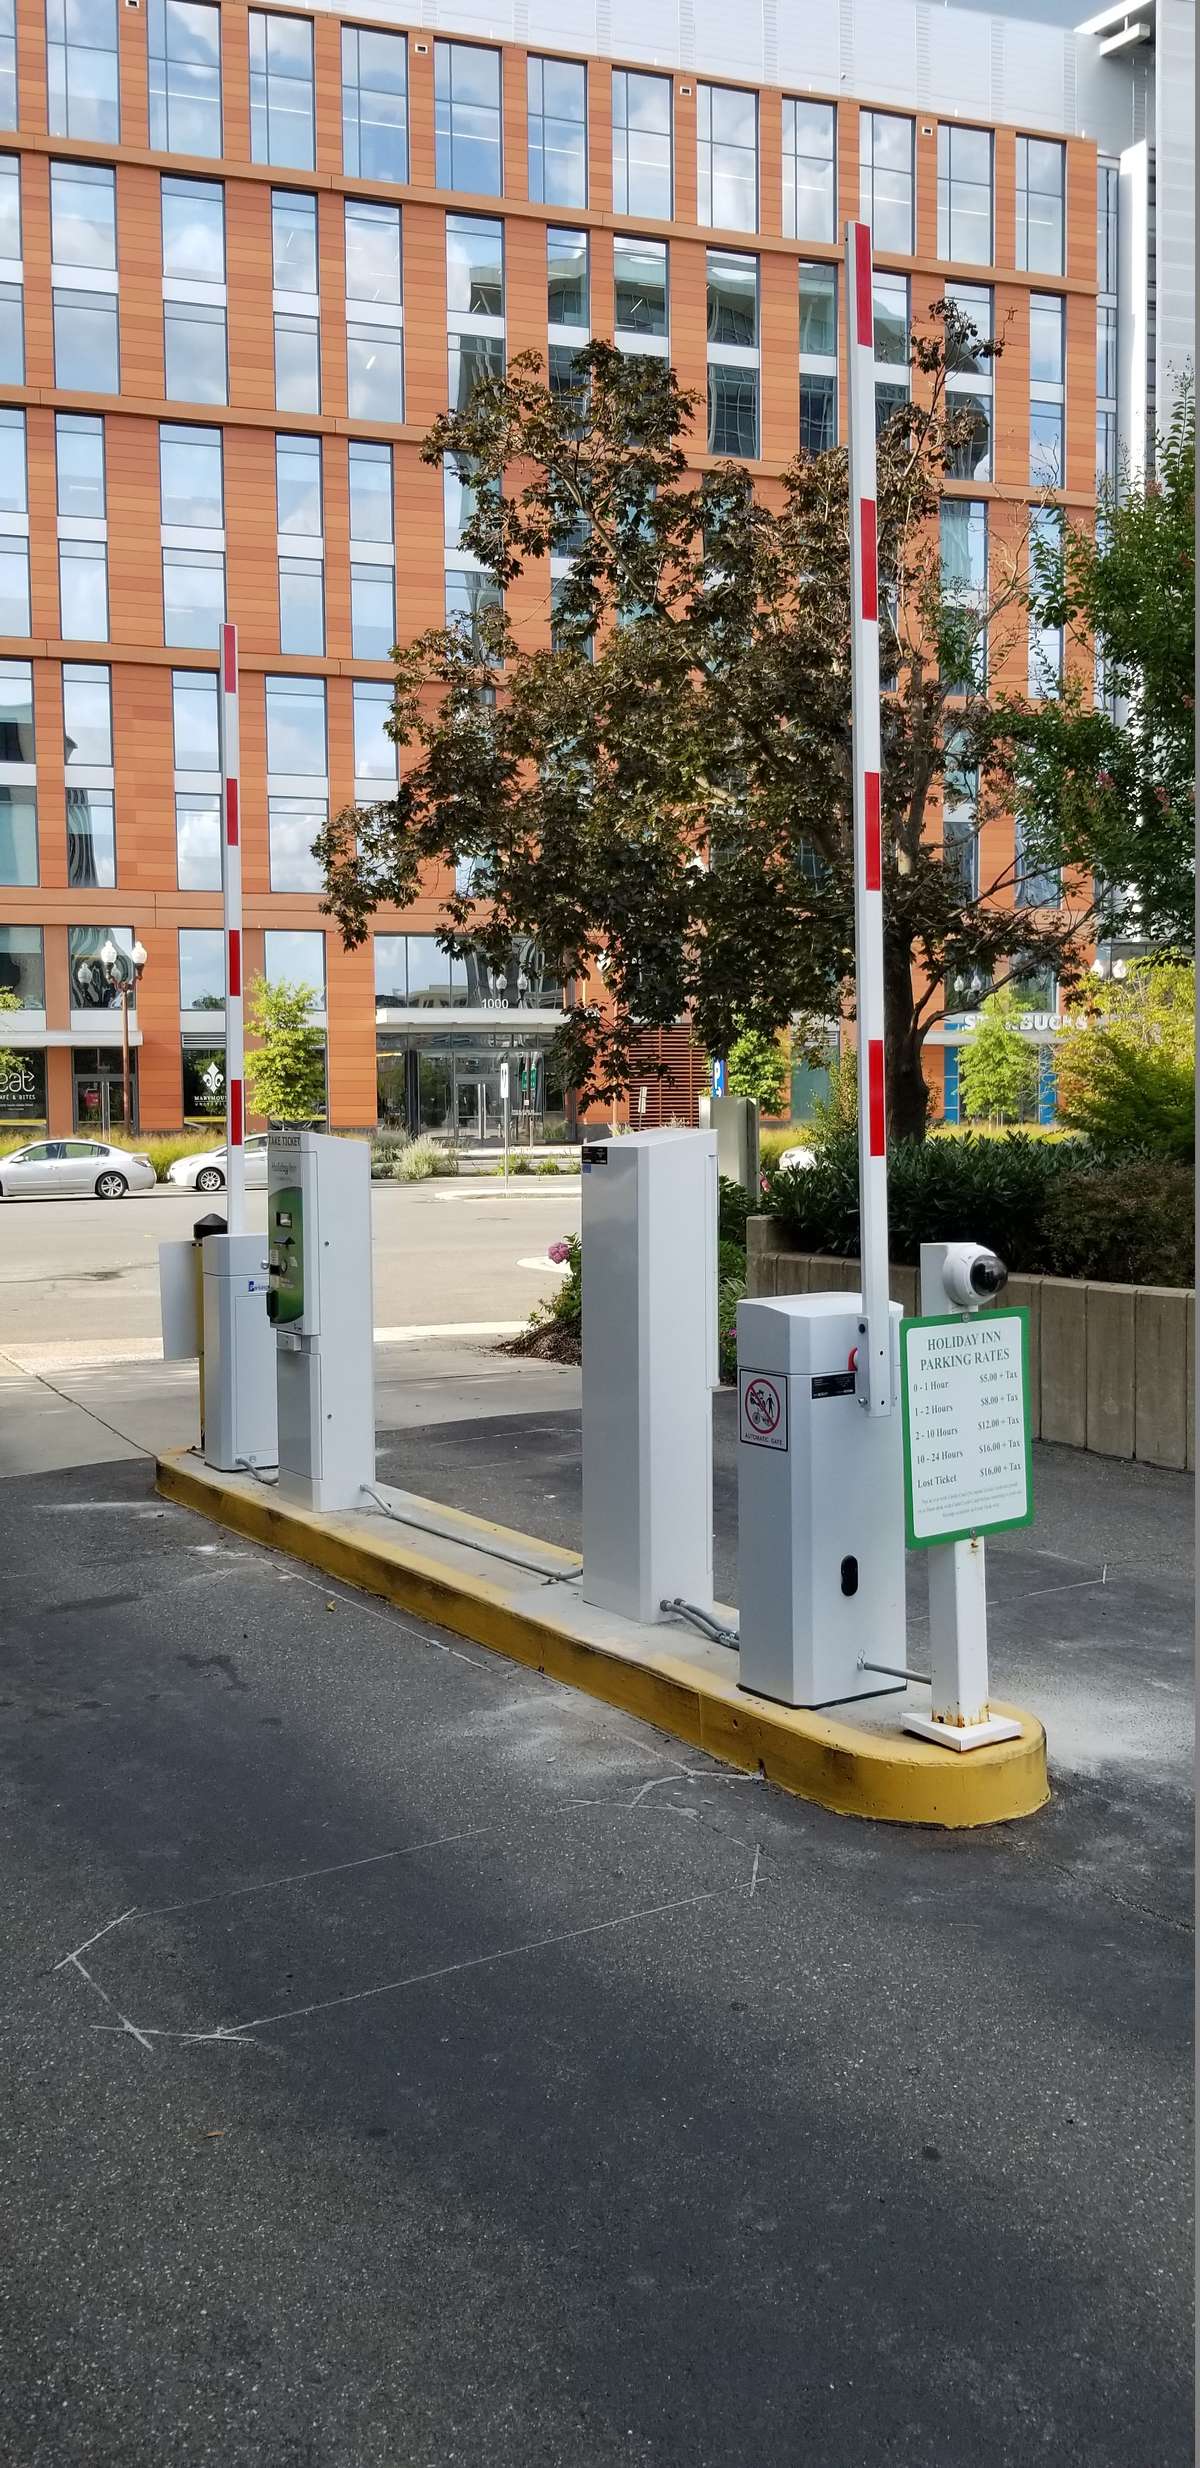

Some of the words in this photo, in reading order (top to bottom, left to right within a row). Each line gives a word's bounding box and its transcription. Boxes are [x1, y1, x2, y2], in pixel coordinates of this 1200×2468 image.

[481, 998, 508, 1009] 1000
[282, 1136, 301, 1147] TICKET
[928, 1333, 979, 1351] HOLIDAY
[982, 1331, 1001, 1344] INN
[921, 1353, 971, 1371] PARKING
[975, 1348, 1010, 1364] RATES
[913, 1384, 918, 1392] 0
[931, 1381, 949, 1391] Hour
[979, 1372, 998, 1383] $5.00
[1006, 1370, 1018, 1379] Tax
[925, 1406, 929, 1415] 2
[931, 1405, 953, 1414] Hours
[980, 1396, 999, 1406] $8.00
[1007, 1393, 1018, 1402] Tax
[915, 1431, 920, 1440] 2
[927, 1430, 935, 1439] 10
[936, 1428, 958, 1437] Hours
[977, 1419, 999, 1431] $12.00
[1008, 1417, 1020, 1425] Tax
[917, 1455, 925, 1464] 10
[931, 1453, 940, 1462] 24
[941, 1450, 963, 1460] Hours
[979, 1442, 1001, 1454] $16.00
[1009, 1440, 1020, 1448] Tax
[917, 1479, 933, 1488] Lost
[935, 1474, 957, 1486] Ticket
[980, 1465, 1001, 1477] $16.00
[1009, 1462, 1021, 1471] Tax
